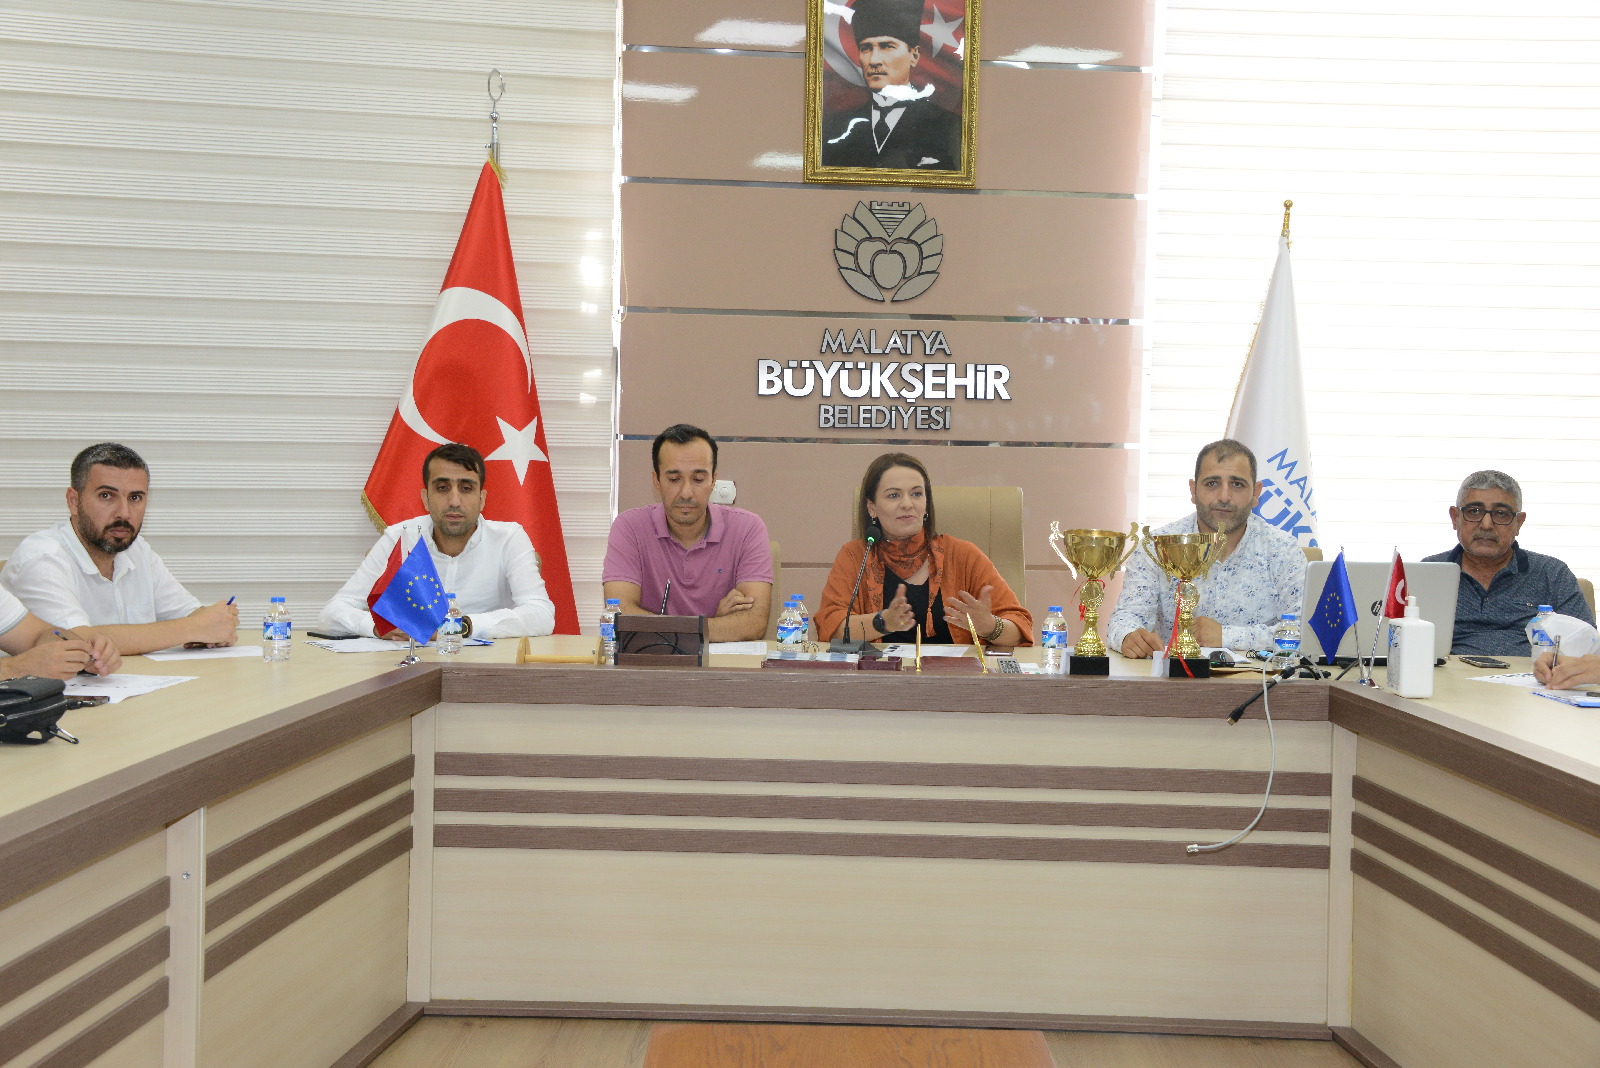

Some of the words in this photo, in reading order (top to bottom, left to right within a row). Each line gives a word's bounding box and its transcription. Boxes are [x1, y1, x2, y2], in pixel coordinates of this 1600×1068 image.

[820, 328, 952, 355] MALATYA
[757, 359, 1012, 403] BÜYÜKŞEHİR
[818, 403, 952, 430] BELEDİYESİ
[1266, 447, 1317, 517] MAL
